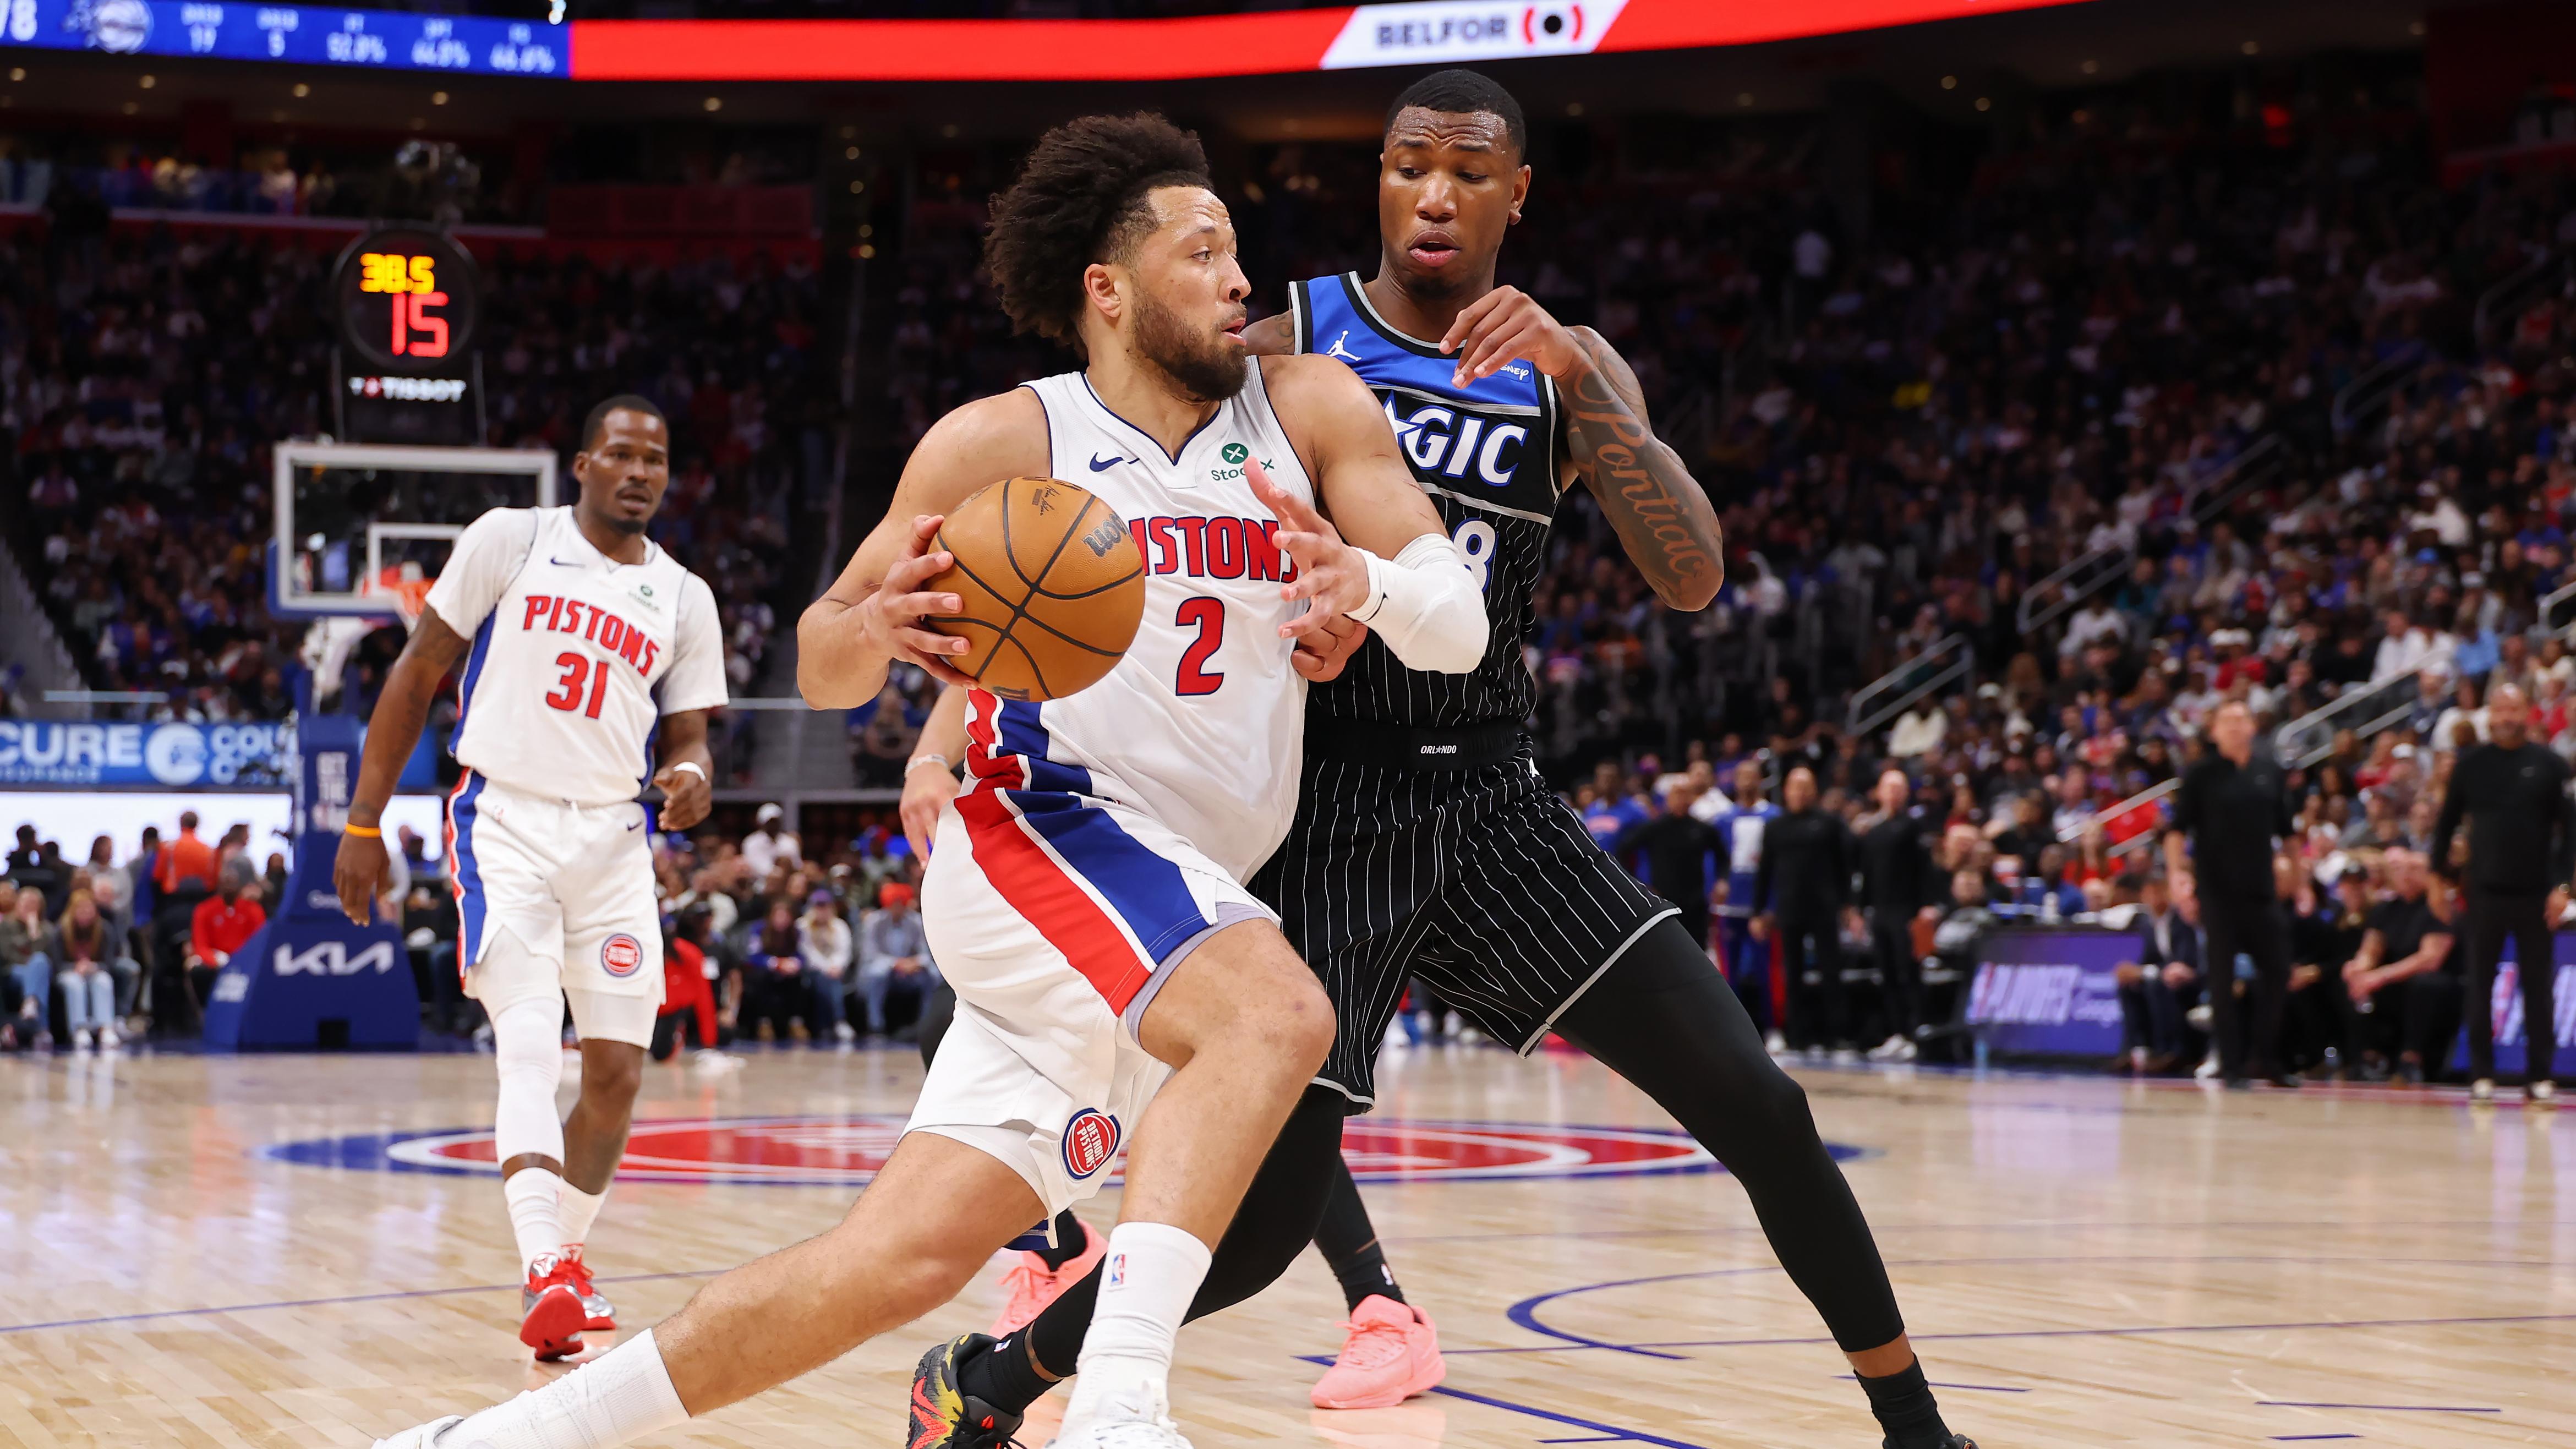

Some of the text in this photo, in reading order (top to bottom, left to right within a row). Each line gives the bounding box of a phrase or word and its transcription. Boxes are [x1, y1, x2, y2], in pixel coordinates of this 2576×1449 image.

[1378, 18, 1507, 47] BELFOR
[392, 292, 449, 357] 15
[1211, 458, 1275, 481] StocX
[1128, 516, 1299, 584] ISTON
[523, 595, 660, 677] PISTONS
[1175, 596, 1225, 697] 2
[545, 652, 610, 719] 31
[1076, 1126, 1096, 1168] PISTONS
[1086, 1120, 1104, 1162] DETROIT
